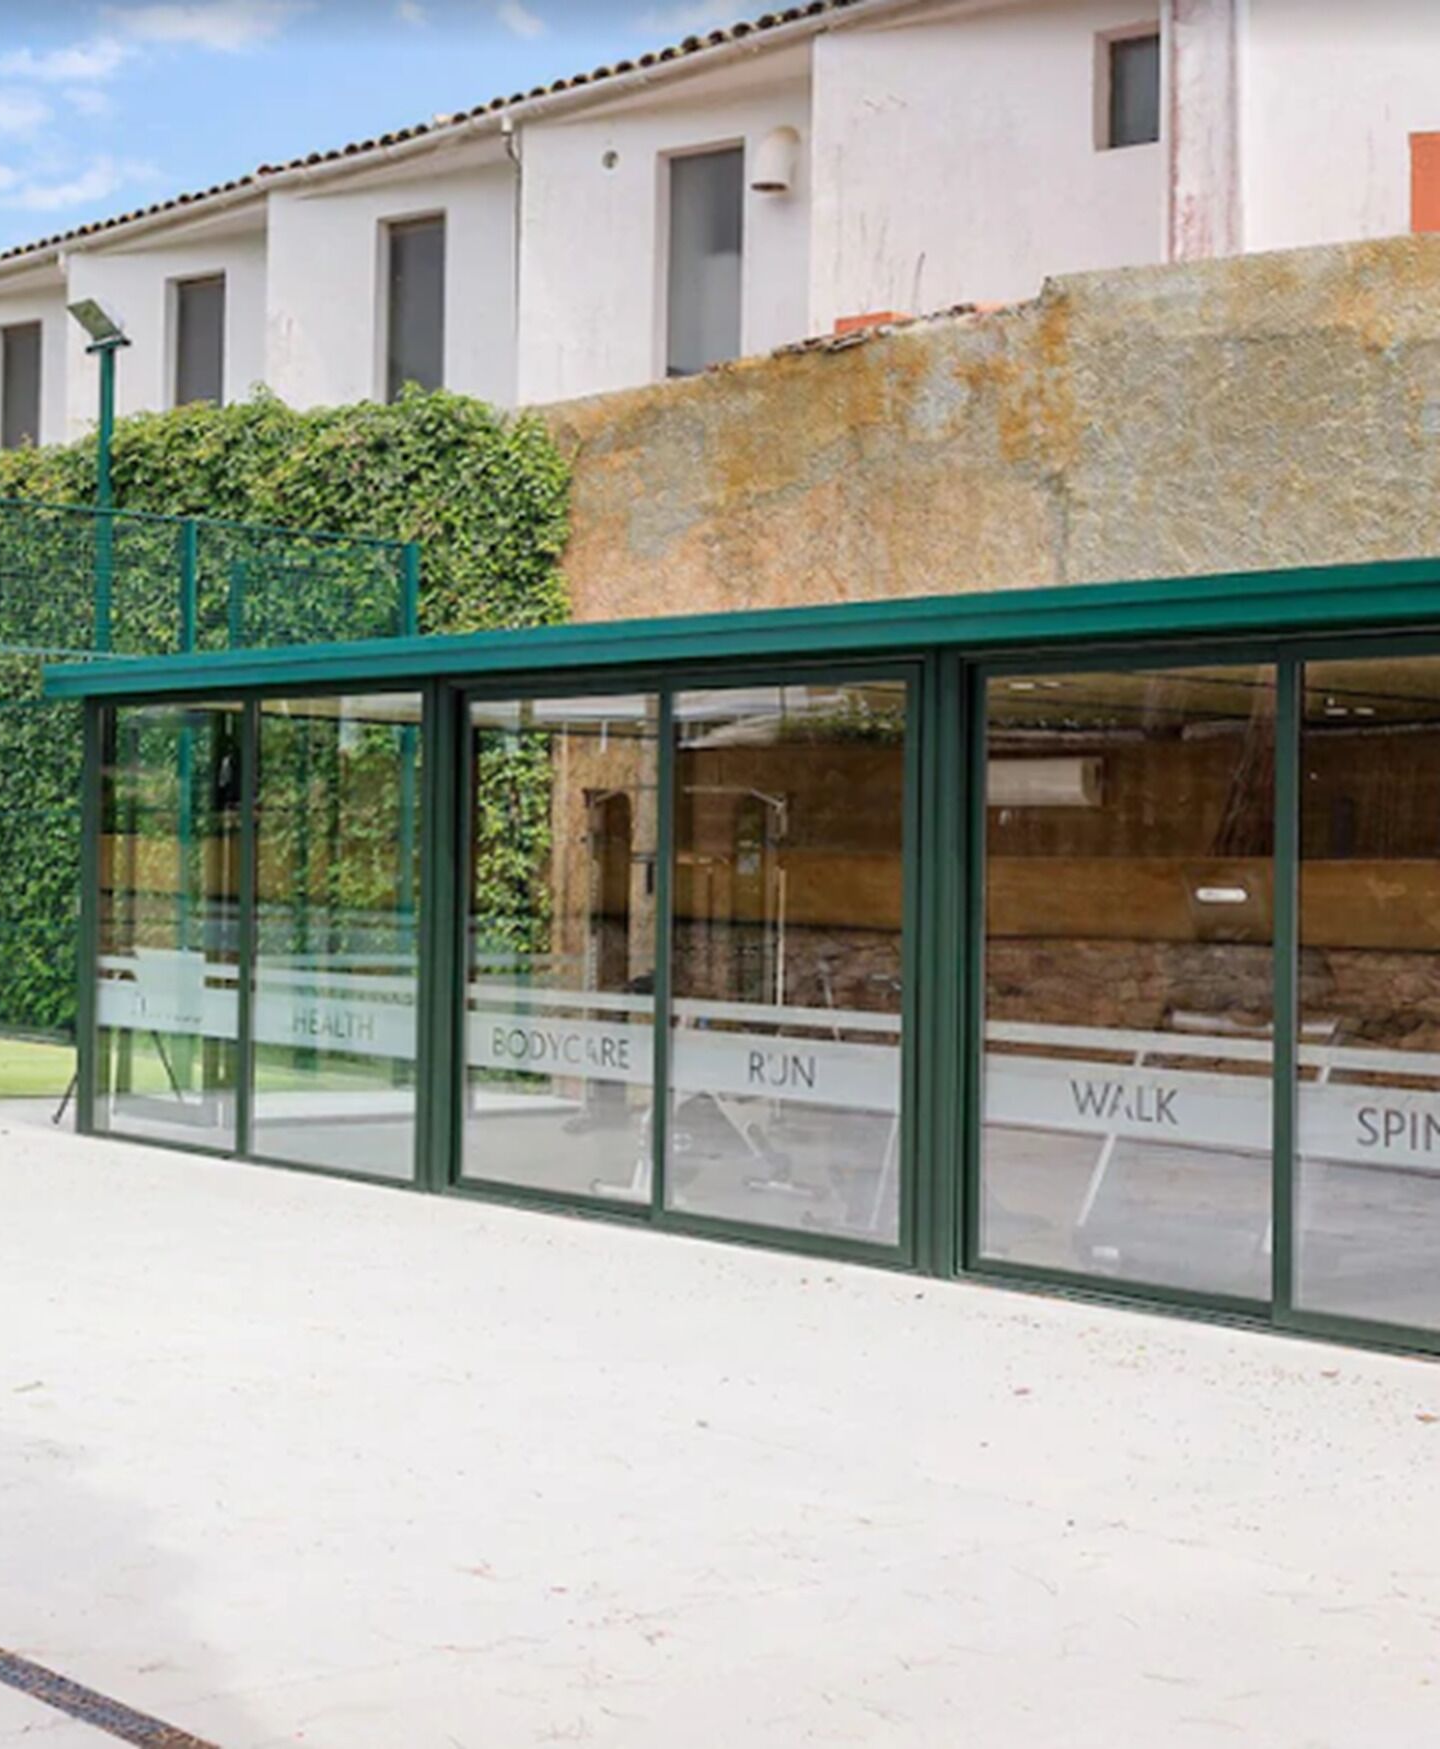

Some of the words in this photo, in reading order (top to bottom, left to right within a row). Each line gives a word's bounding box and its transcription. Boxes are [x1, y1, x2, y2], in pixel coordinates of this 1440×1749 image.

[292, 1007, 375, 1041] HEALTH
[491, 1026, 631, 1070] BODYCARE
[749, 1050, 816, 1088] RUN
[1070, 1079, 1178, 1125] WALK
